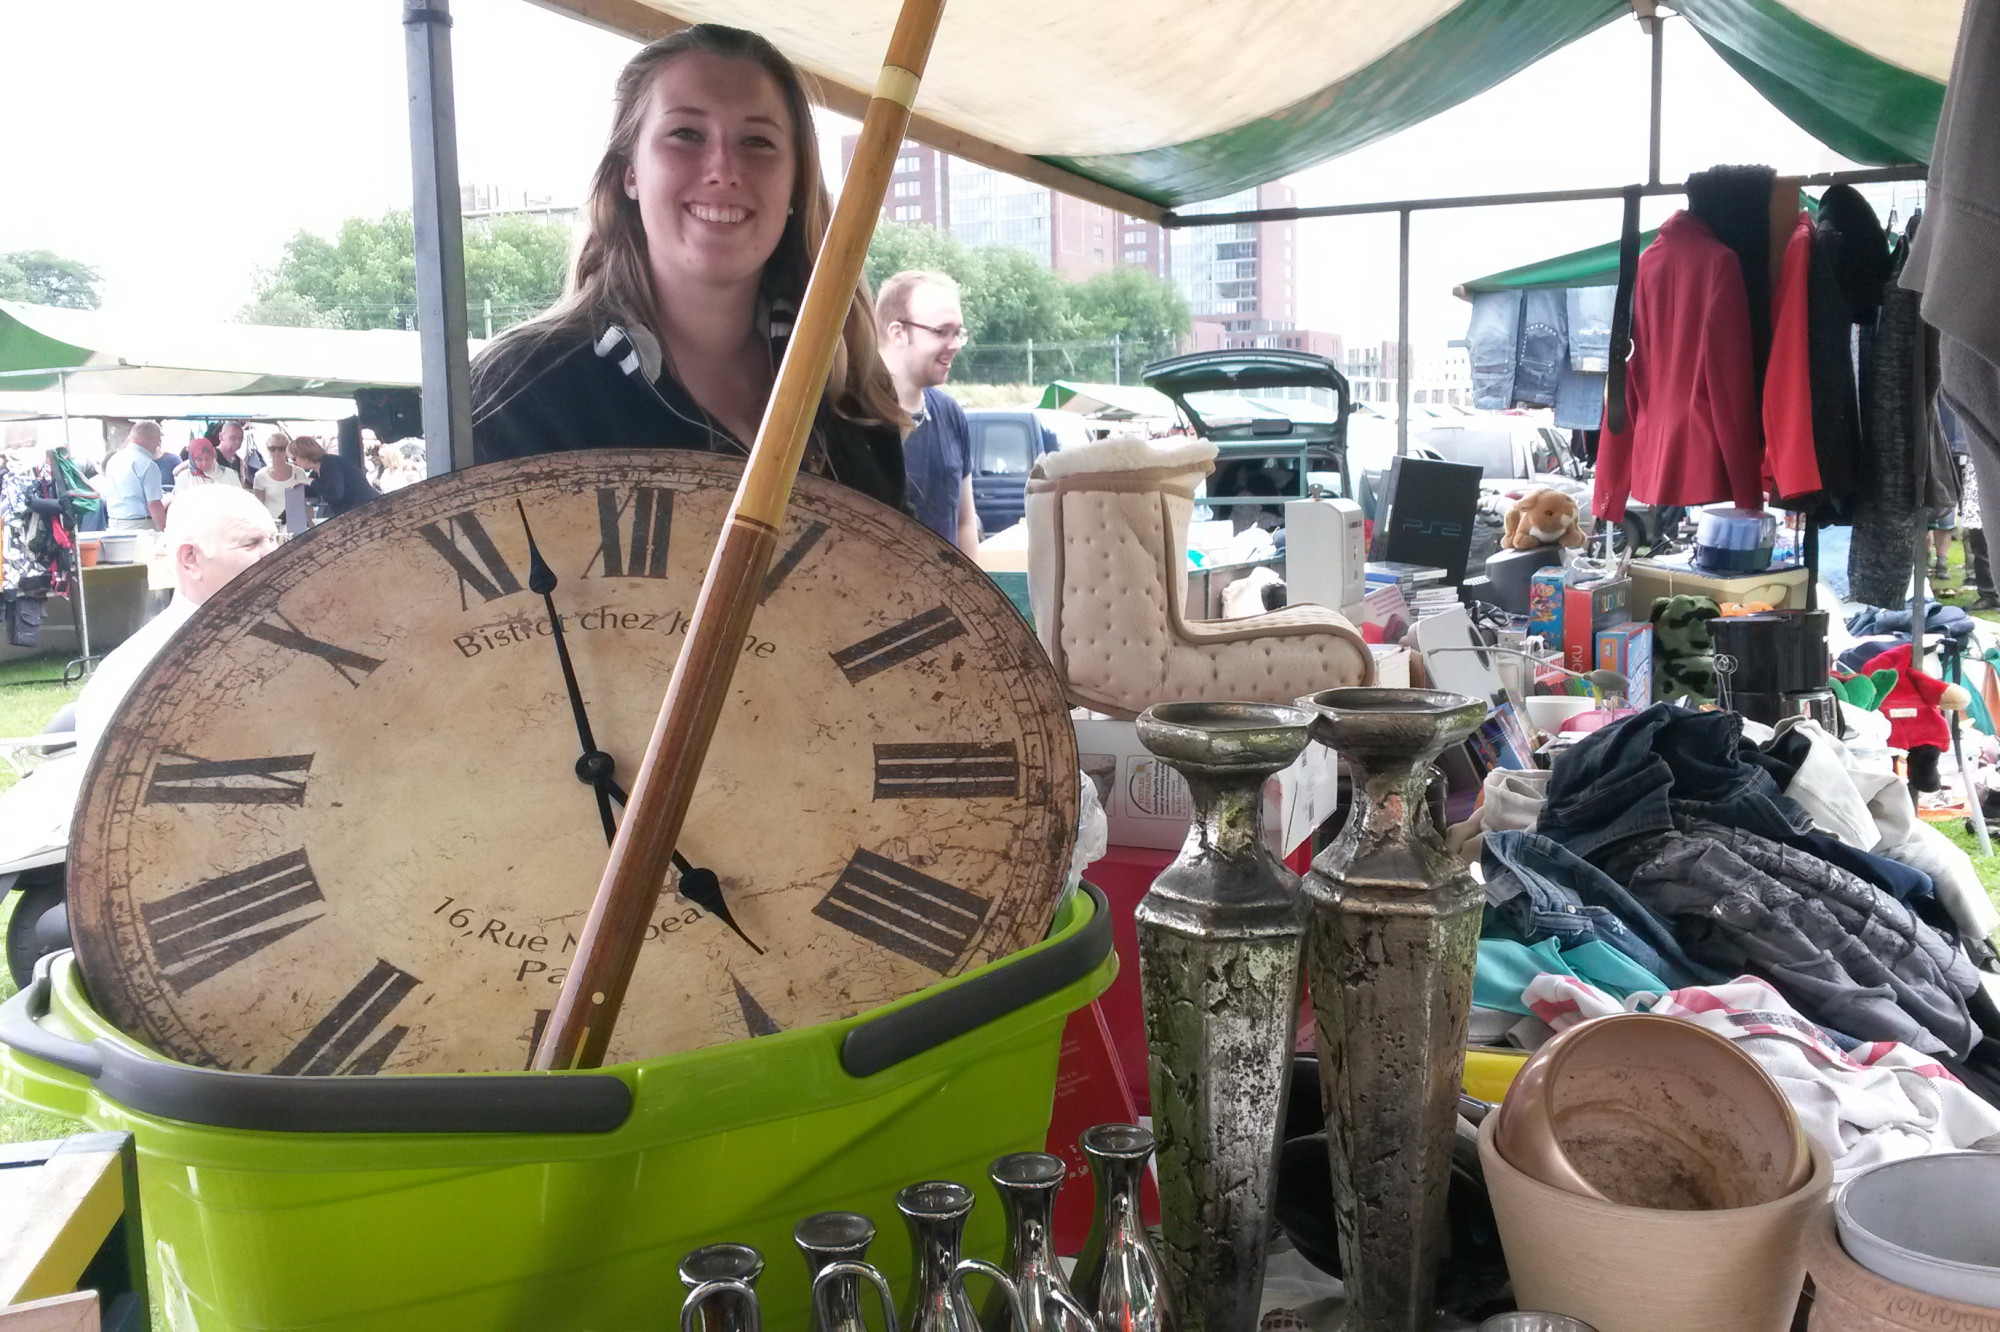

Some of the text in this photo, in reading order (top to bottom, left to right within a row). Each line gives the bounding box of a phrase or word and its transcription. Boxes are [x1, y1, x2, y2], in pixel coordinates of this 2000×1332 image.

[580, 487, 675, 580] XII
[1402, 519, 1462, 536] PS2
[416, 510, 527, 612] XI
[580, 605, 656, 631] chez
[246, 607, 387, 688] X
[1571, 644, 1583, 673] OKU
